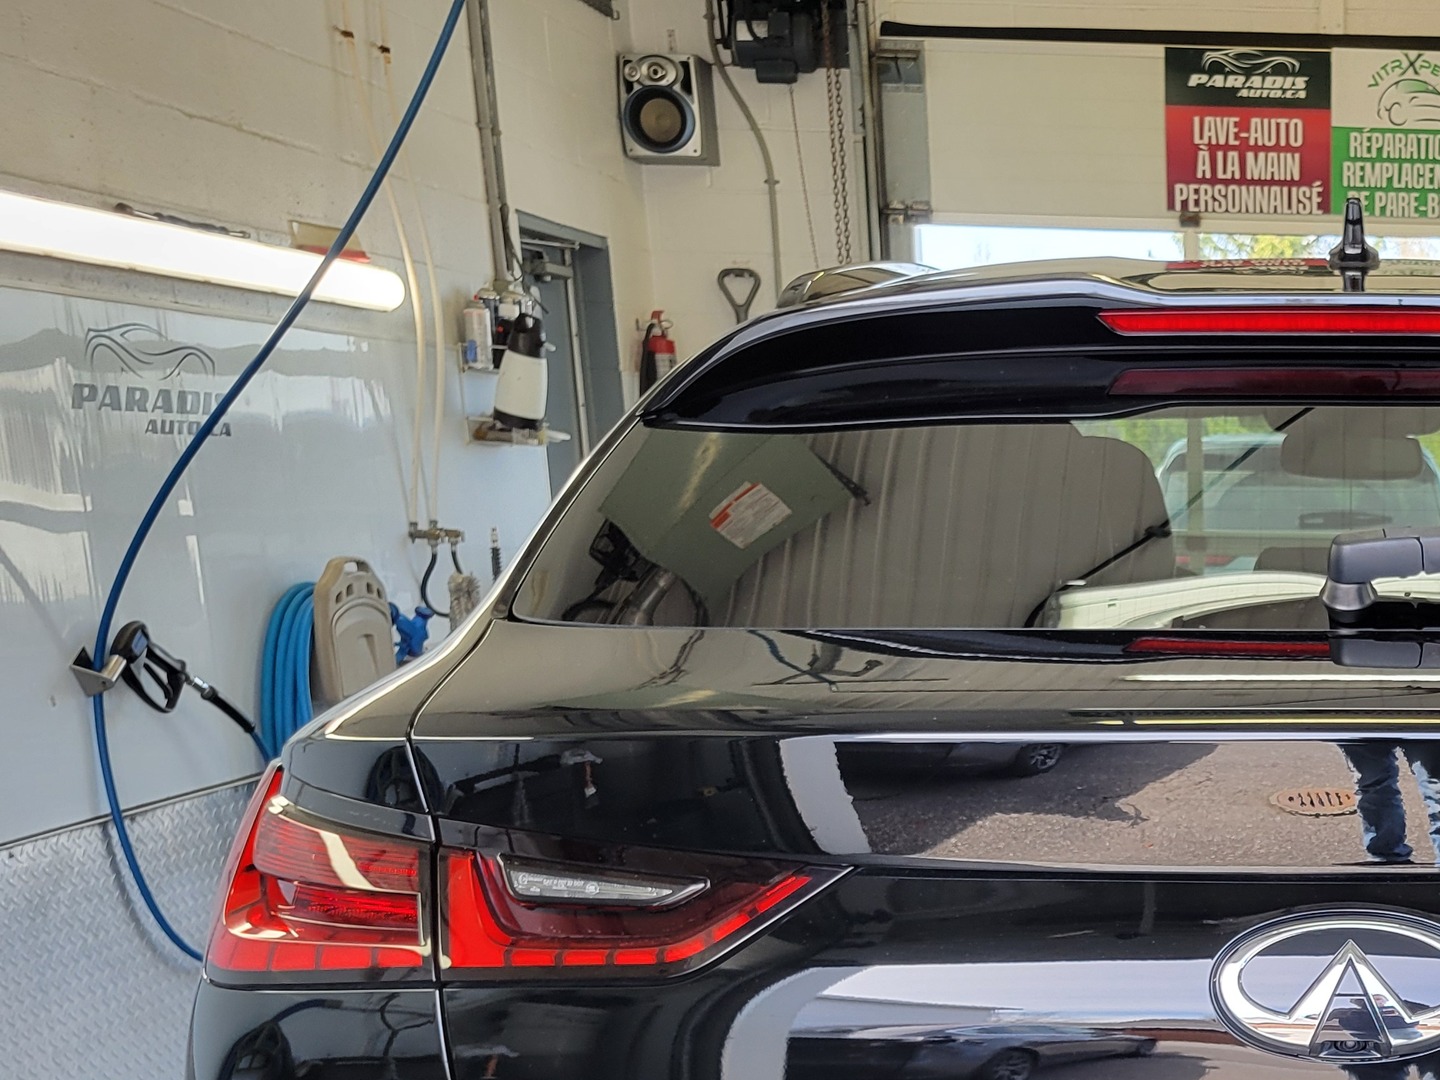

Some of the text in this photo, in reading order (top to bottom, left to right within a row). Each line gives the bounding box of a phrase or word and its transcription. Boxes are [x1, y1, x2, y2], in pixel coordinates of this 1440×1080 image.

[1187, 74, 1309, 91] PARADIS
[1236, 89, 1307, 100] AUTO.CA
[1193, 116, 1303, 147] LAVE-AUTO
[1196, 144, 1300, 181] À LA MAIN
[1174, 181, 1324, 216] PERSONNALISÉ
